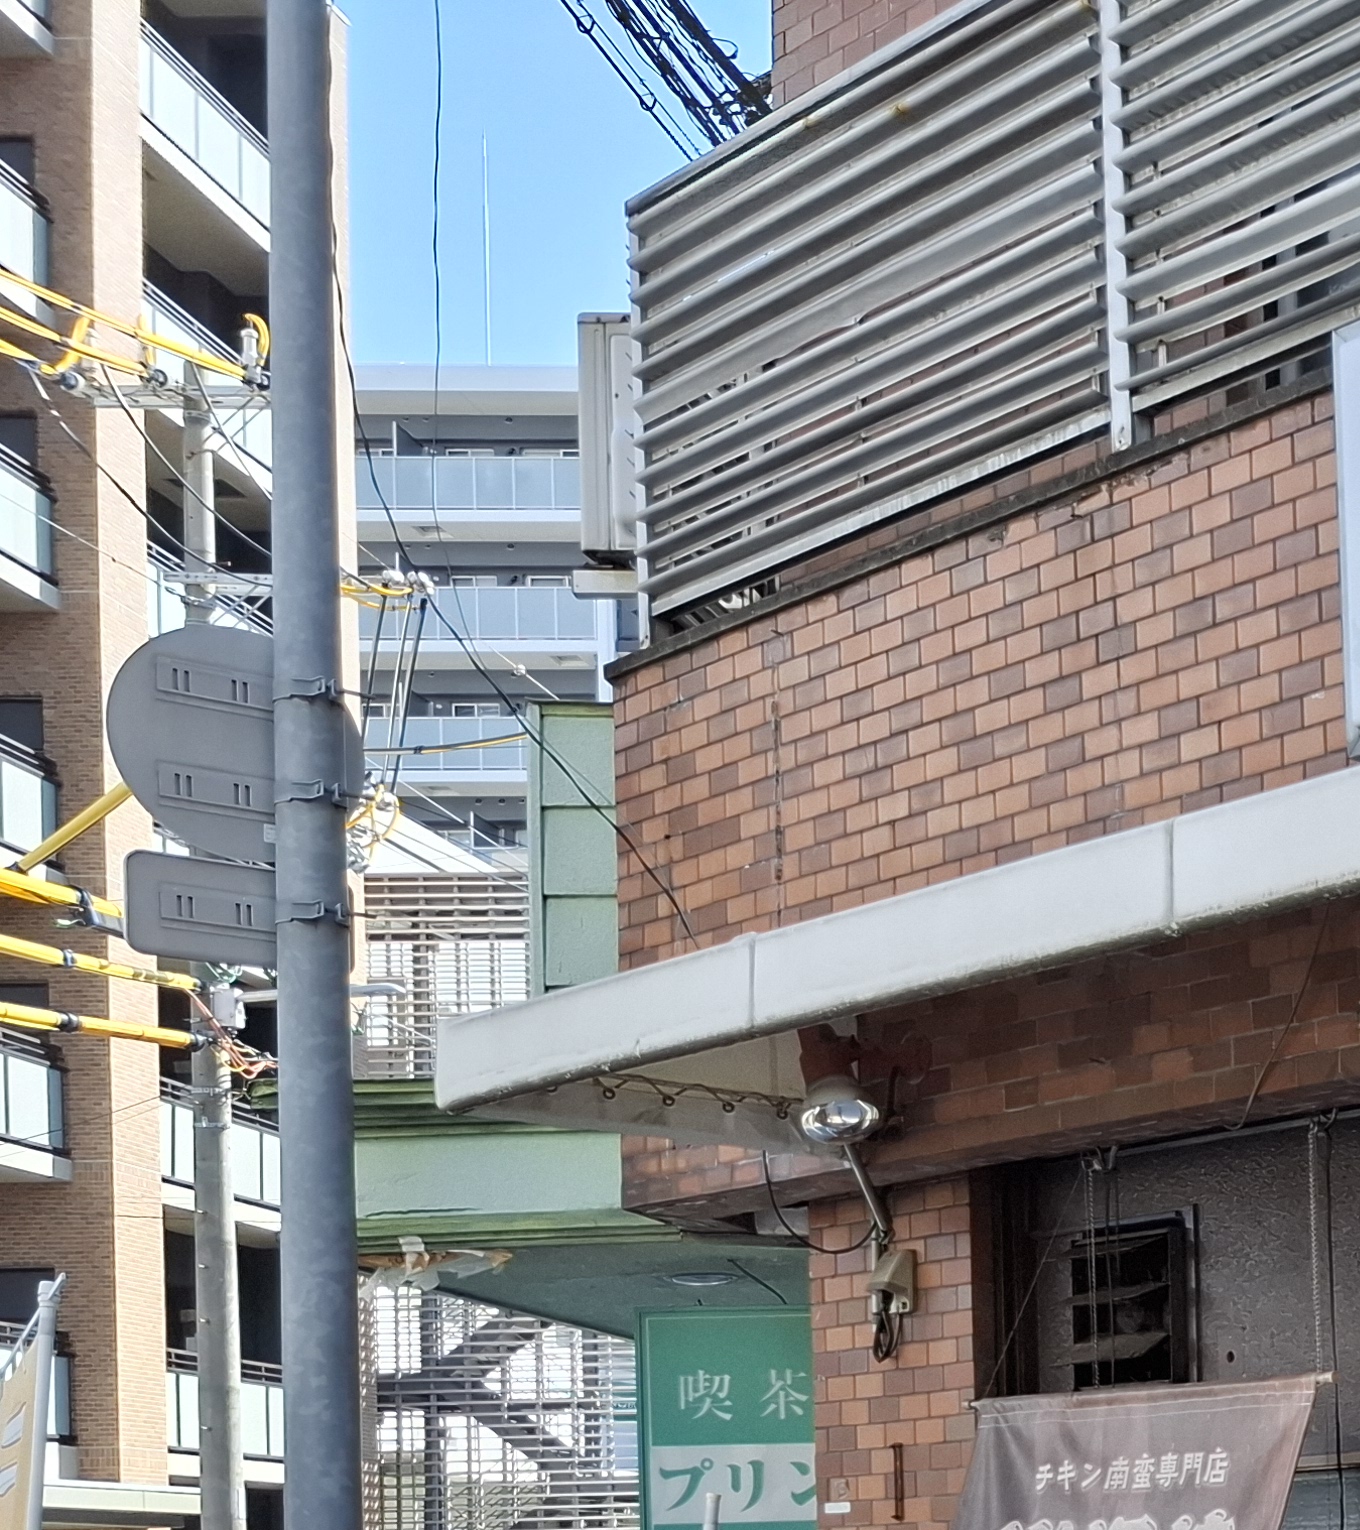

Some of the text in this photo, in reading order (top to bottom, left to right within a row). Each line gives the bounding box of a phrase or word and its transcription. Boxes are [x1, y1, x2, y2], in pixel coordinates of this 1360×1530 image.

[679, 1369, 809, 1421] 喫茶
[1035, 1447, 1229, 1492] チキン南蛮専門店
